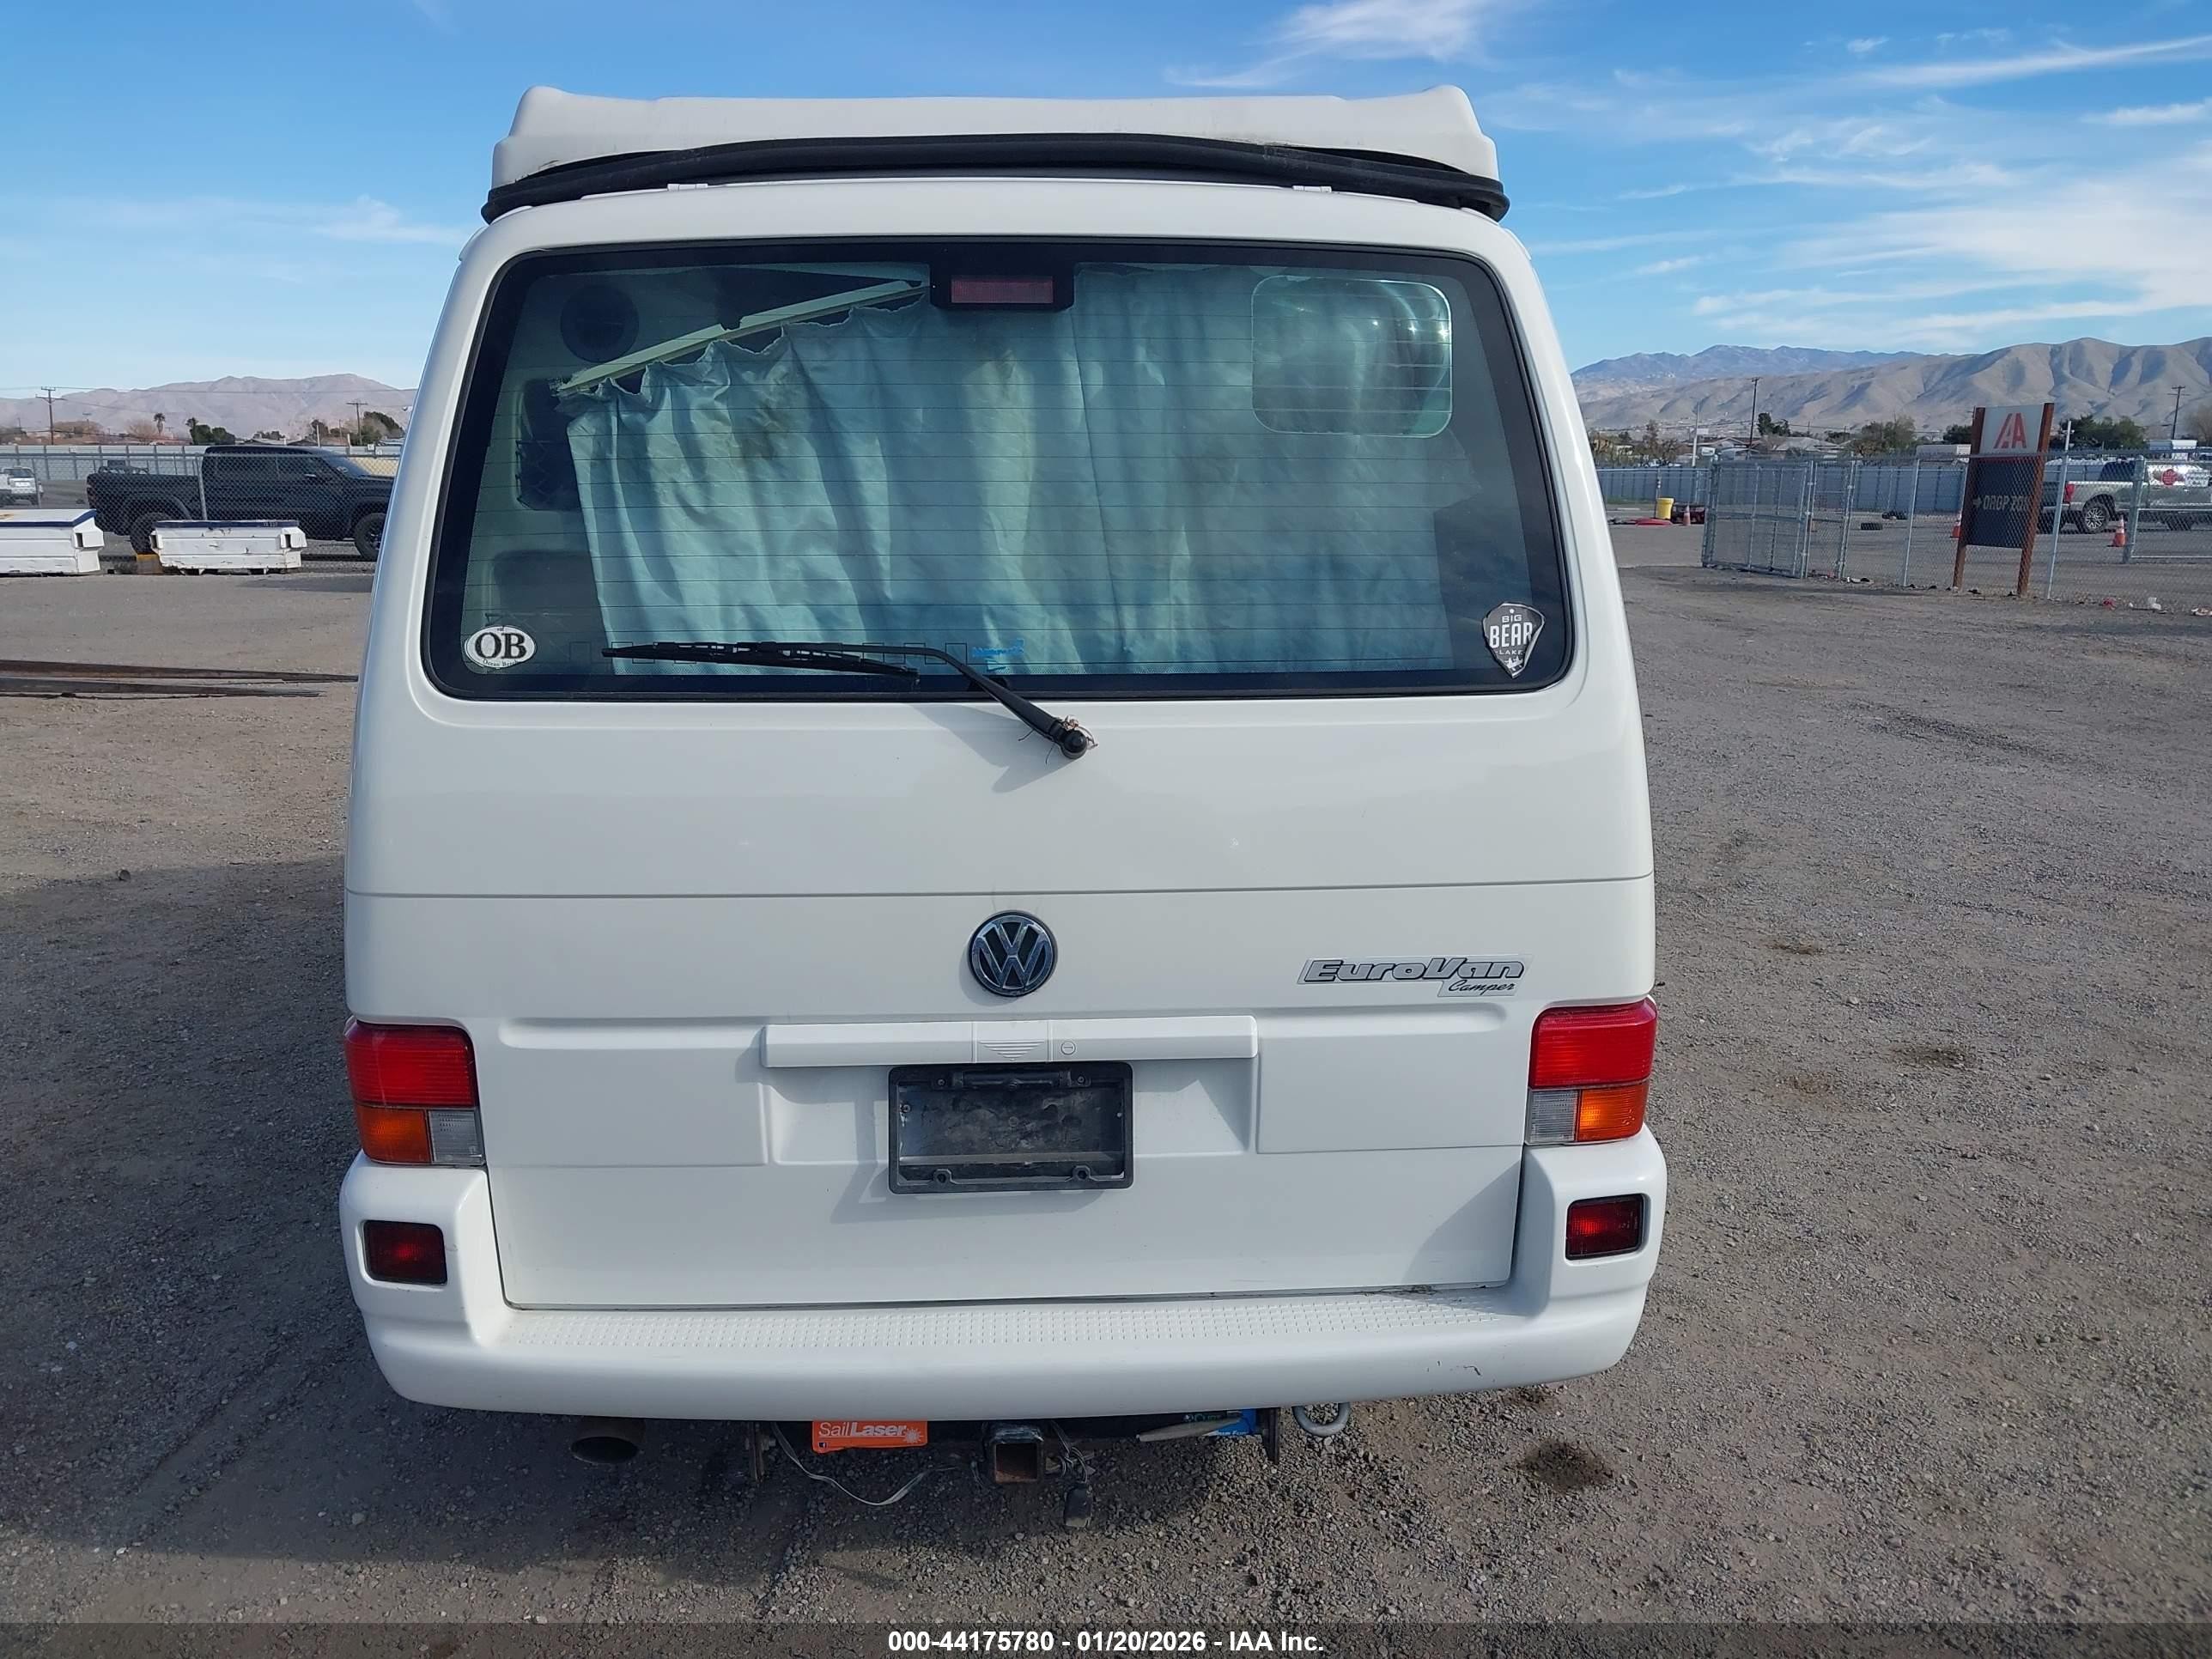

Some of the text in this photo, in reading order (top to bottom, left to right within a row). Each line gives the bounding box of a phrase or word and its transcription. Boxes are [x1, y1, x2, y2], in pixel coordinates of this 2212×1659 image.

[1983, 495, 2010, 511] DROP
[1501, 614, 1522, 623] BIG
[475, 631, 527, 659] OB
[1489, 622, 1534, 649] BEAR
[483, 659, 501, 667] Ocean
[971, 915, 1054, 995] VW
[1304, 957, 1525, 982] EuroVan
[1448, 979, 1516, 996] Camper
